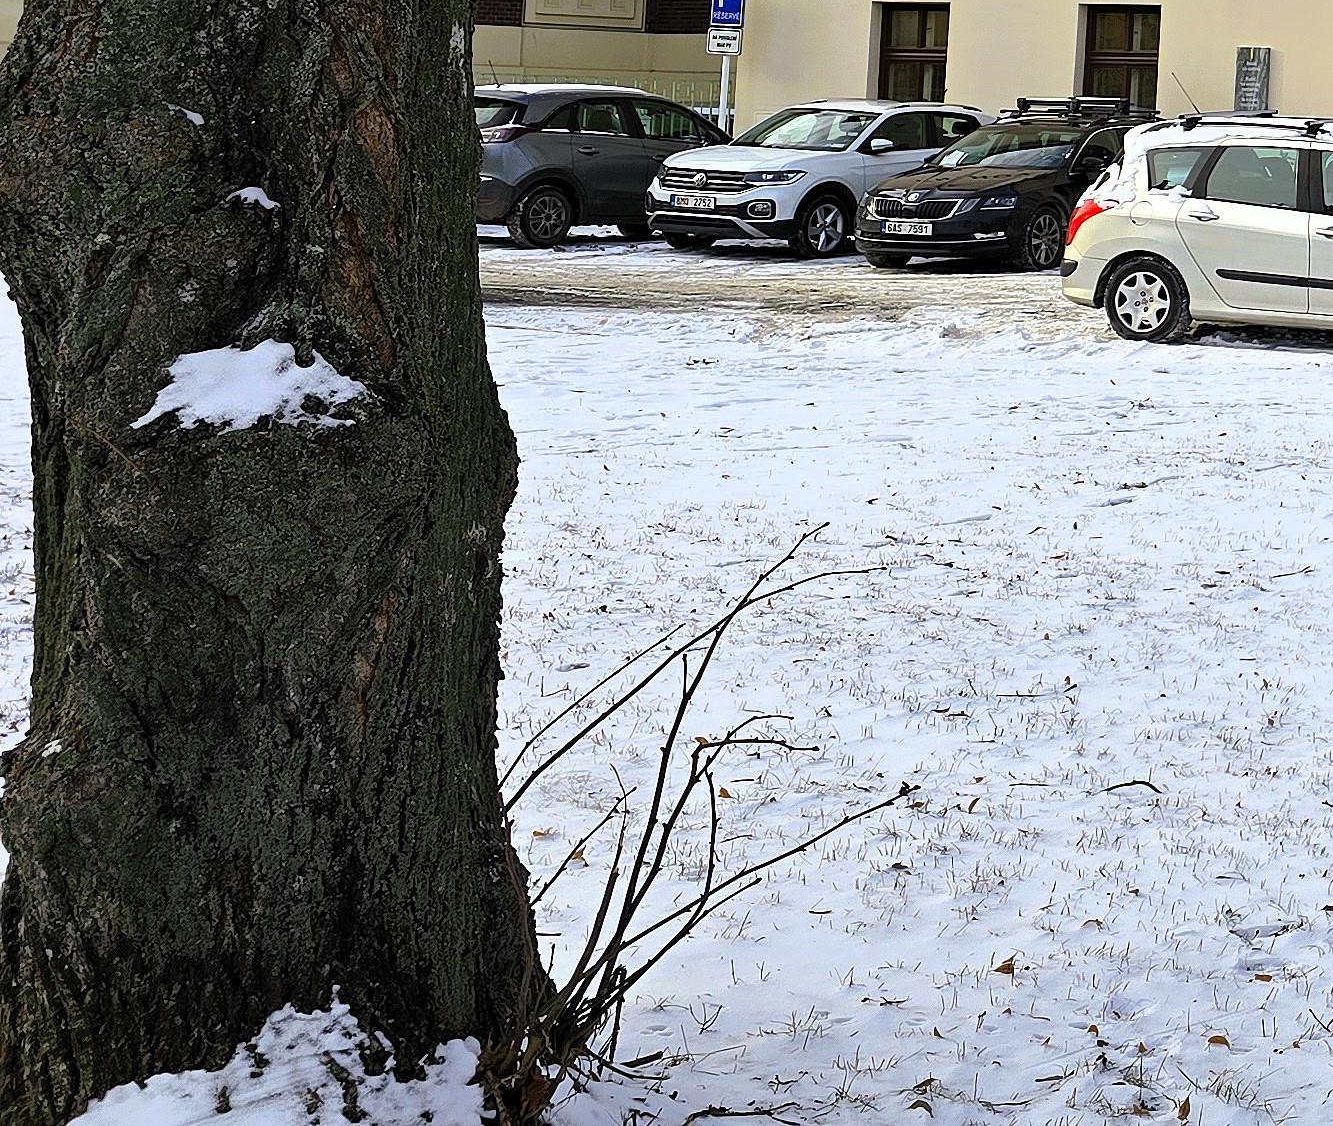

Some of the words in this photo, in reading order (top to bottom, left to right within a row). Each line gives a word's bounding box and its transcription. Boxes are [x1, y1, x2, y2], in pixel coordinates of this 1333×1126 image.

[693, 197, 712, 208] 2752
[887, 223, 903, 233] 6AS
[907, 224, 928, 234] 7591
